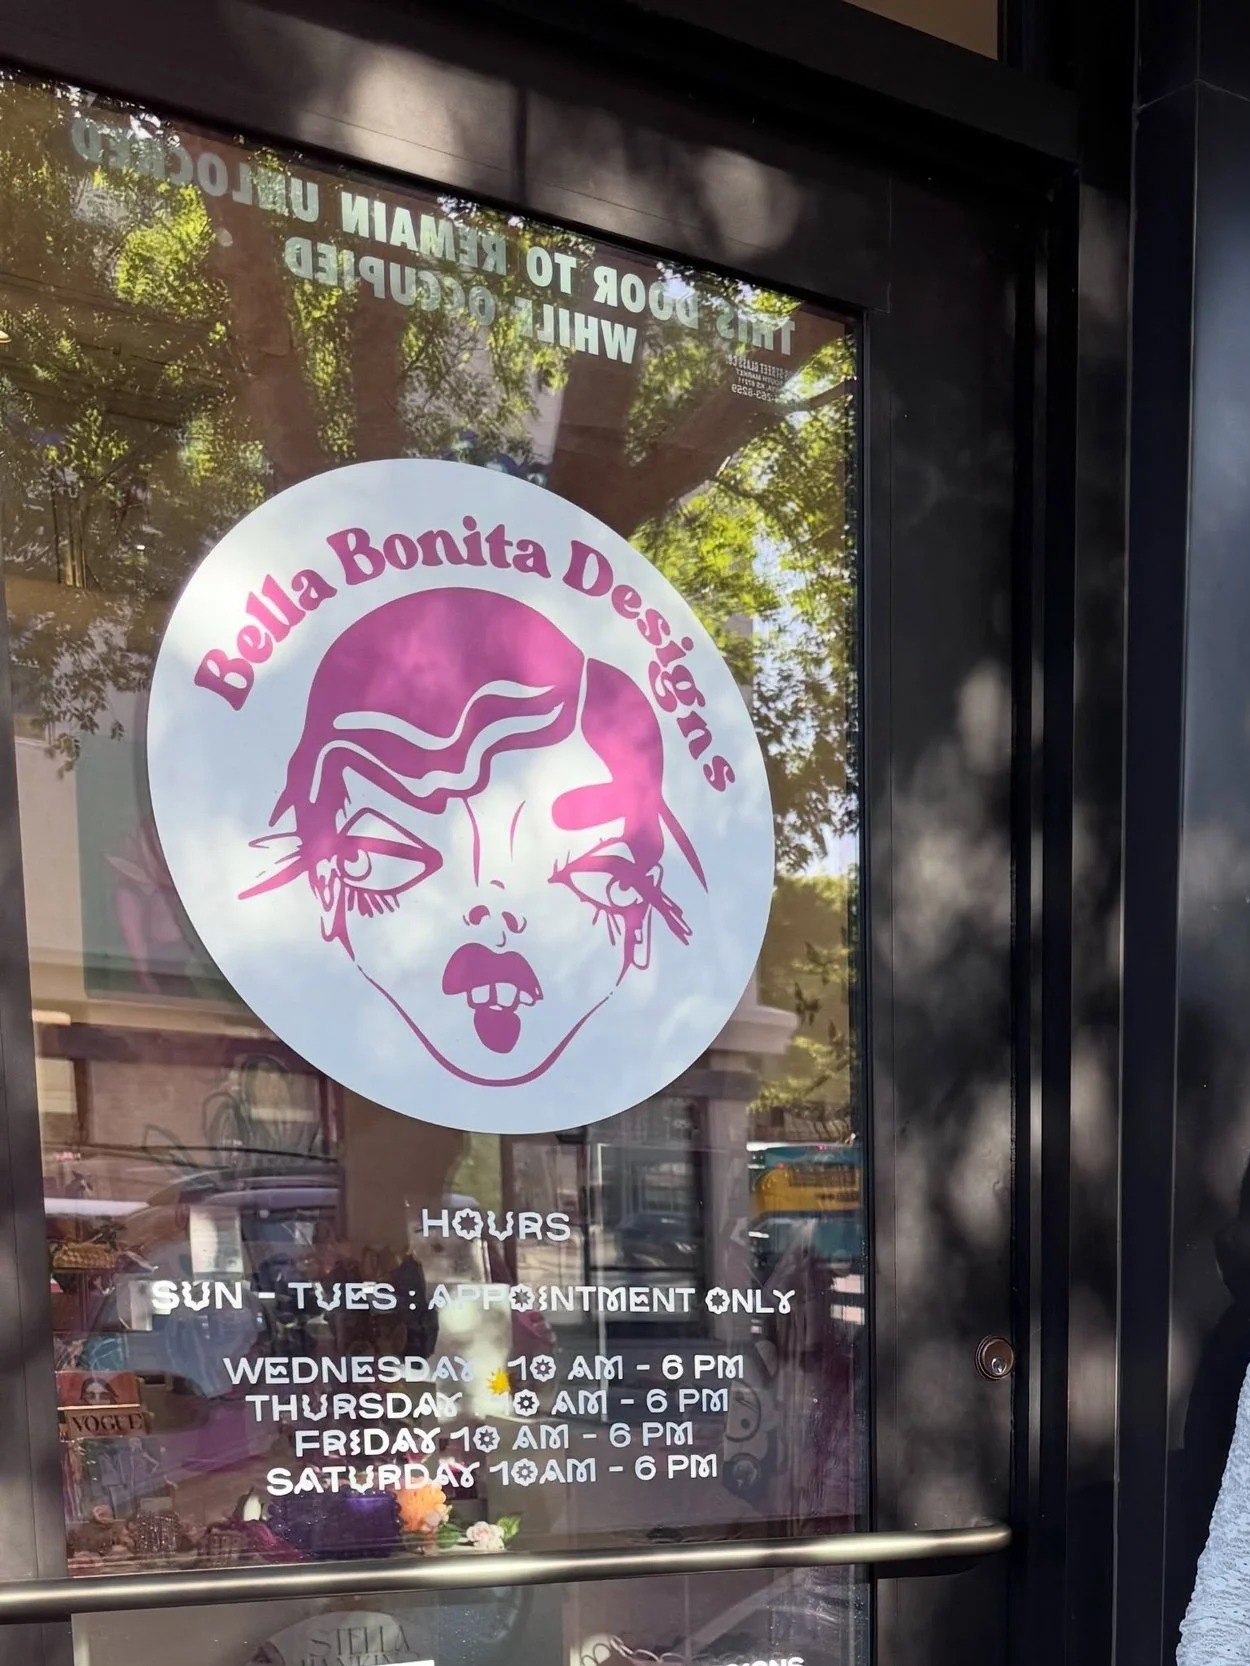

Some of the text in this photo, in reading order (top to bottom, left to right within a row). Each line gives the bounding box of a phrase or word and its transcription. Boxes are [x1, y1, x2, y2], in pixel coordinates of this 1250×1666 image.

[194, 515, 736, 793] Bella Bonita Designs
[421, 1208, 571, 1241] HOURS
[151, 1280, 243, 1312] SUN
[288, 1282, 397, 1312] TUES
[428, 1282, 695, 1313] APPOINTMENT
[705, 1286, 796, 1315] ONLY
[223, 1355, 475, 1385] WEDNESDAY
[508, 1354, 557, 1383] 10
[568, 1355, 624, 1381] AM
[661, 1354, 684, 1381] 6
[694, 1354, 744, 1380] PM
[245, 1391, 463, 1422] THURSDAY
[551, 1389, 608, 1415] AM
[646, 1388, 668, 1414] 6
[679, 1387, 729, 1413] PM
[72, 1412, 142, 1433] VOGUE
[295, 1426, 441, 1457] FRIDAY
[450, 1425, 500, 1454] 10
[512, 1424, 569, 1450] AM
[609, 1422, 632, 1448] 6
[642, 1421, 694, 1447] PM
[266, 1461, 481, 1496] SATURDAY
[489, 1457, 597, 1487] 10AM
[634, 1455, 657, 1481] 6
[667, 1453, 718, 1479] PM
[310, 1625, 410, 1657] STELLA
